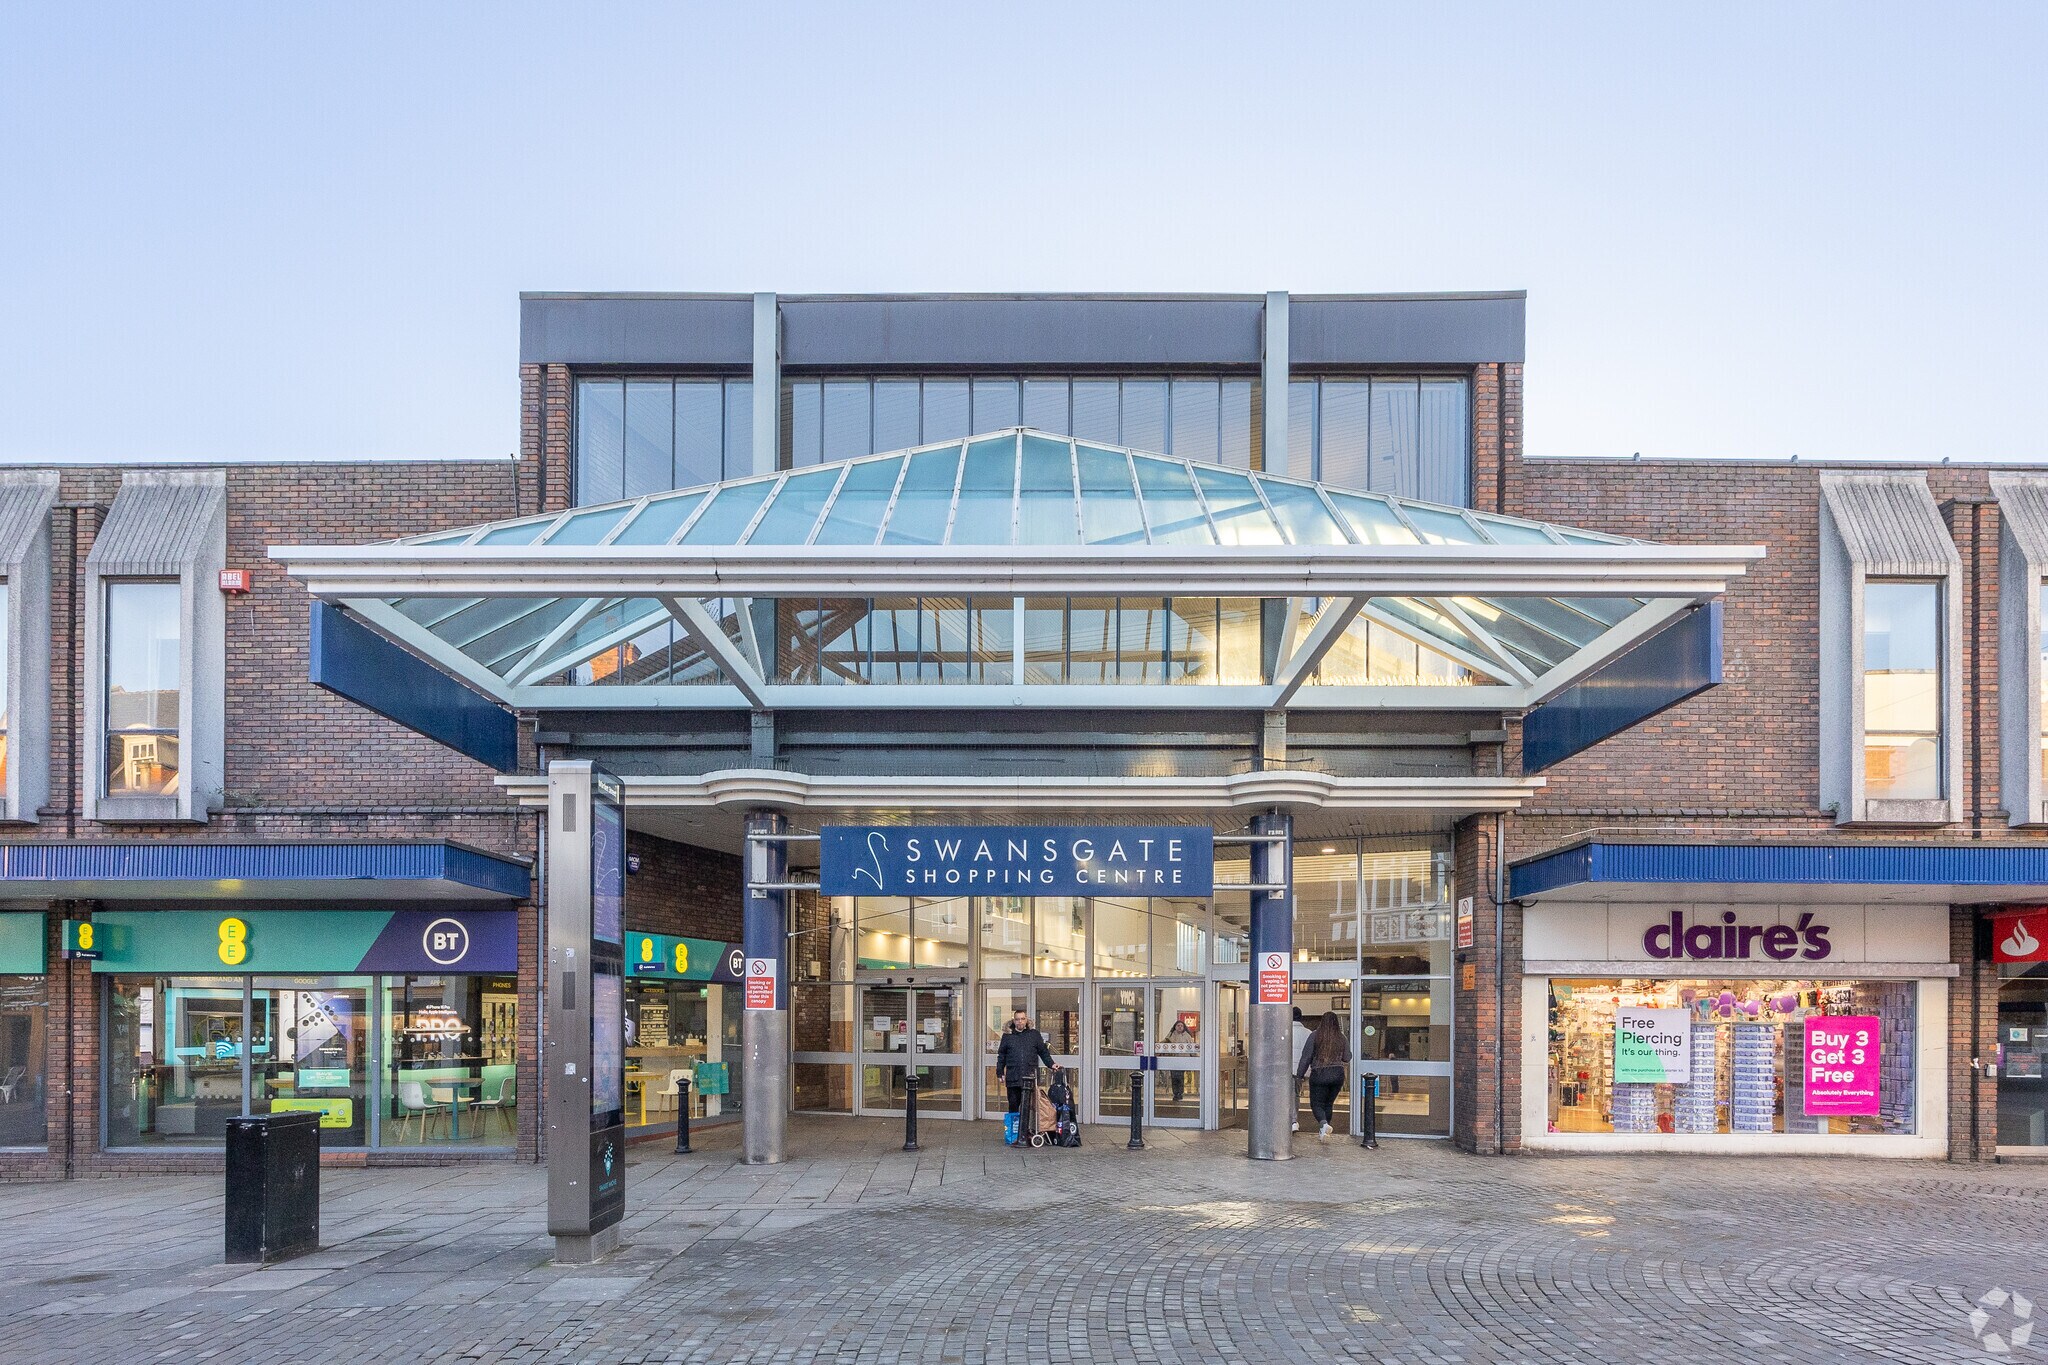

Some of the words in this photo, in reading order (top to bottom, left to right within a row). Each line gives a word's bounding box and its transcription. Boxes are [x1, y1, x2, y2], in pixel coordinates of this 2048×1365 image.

[222, 572, 241, 580] ABEL
[906, 839, 1182, 862] SWANSGATE
[906, 869, 1054, 883] SHOPPING
[1076, 869, 1182, 883] CENTRE
[433, 933, 459, 950] BT
[1643, 911, 1831, 960] claire's
[733, 958, 743, 969] BT
[416, 1019, 460, 1040] PRO
[1622, 1016, 1655, 1029] Free
[1811, 1030, 1850, 1049] Buy
[1855, 1030, 1869, 1046] 3
[1621, 1048, 1635, 1056] It's
[1655, 1048, 1681, 1057] thing.
[1811, 1049, 1845, 1064] Get
[1851, 1049, 1865, 1065] 3
